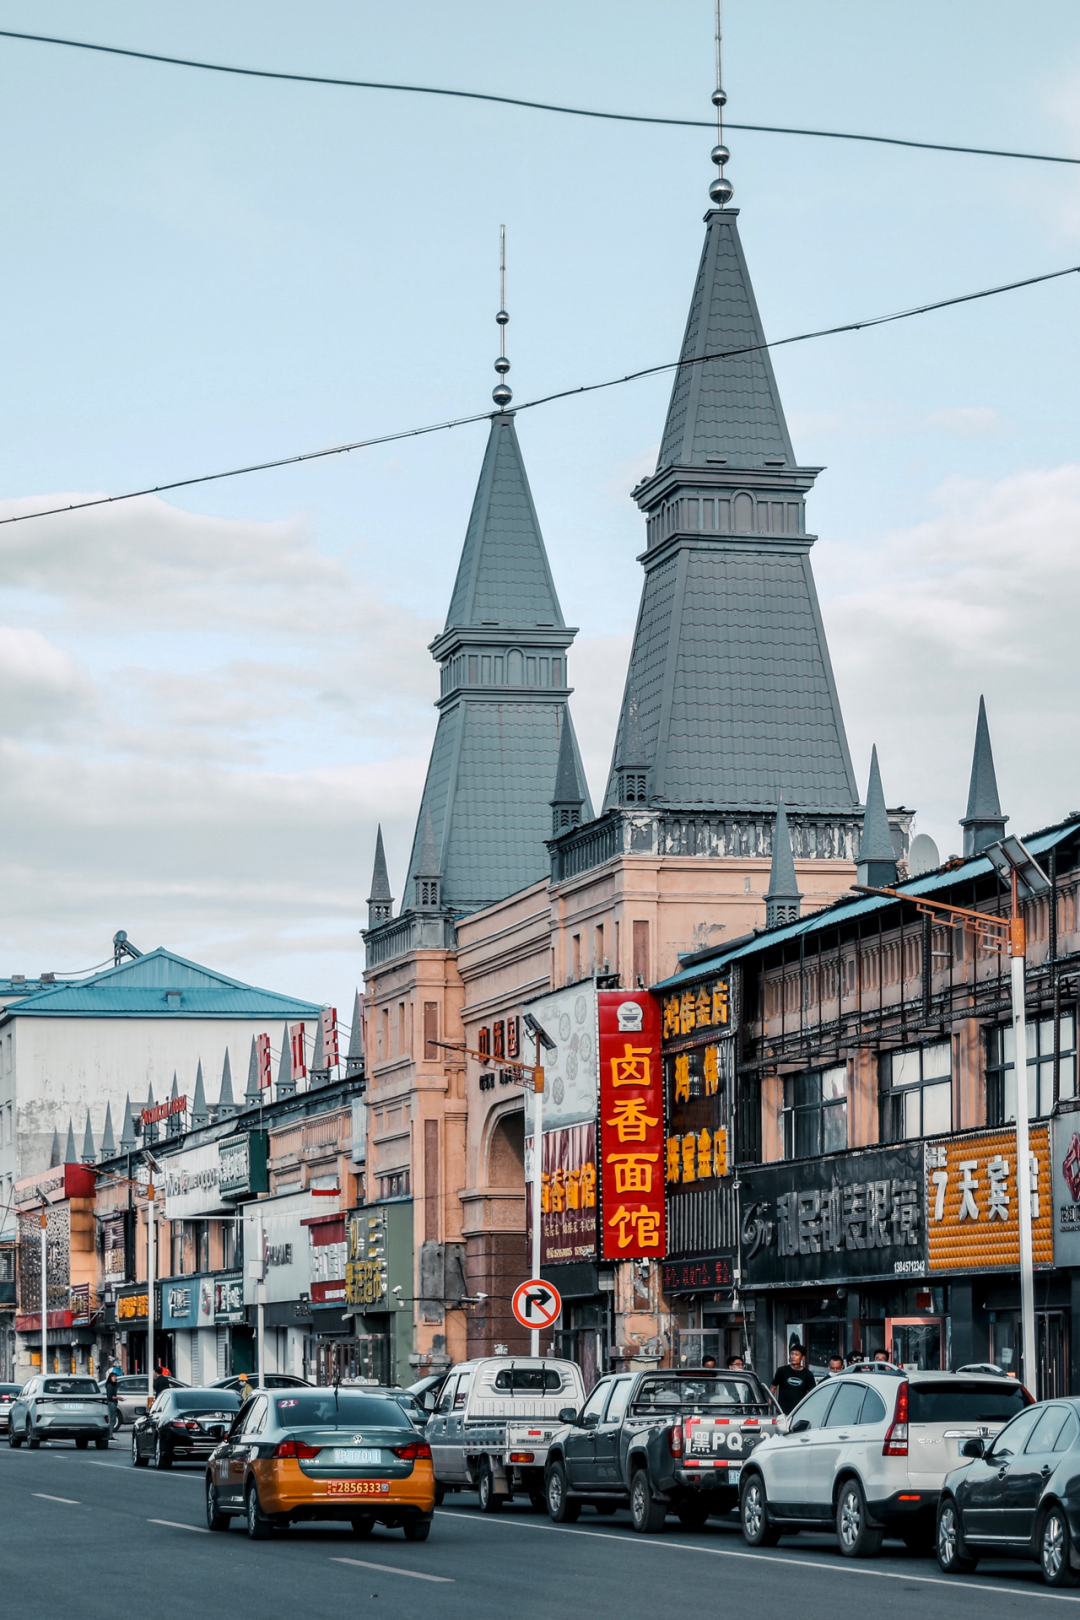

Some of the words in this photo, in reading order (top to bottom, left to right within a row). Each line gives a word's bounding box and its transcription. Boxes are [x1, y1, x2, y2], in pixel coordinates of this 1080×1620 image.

[606, 1043, 660, 1248] 卤香面馆
[281, 1400, 296, 1408] 21
[337, 1482, 381, 1493] 2856333
